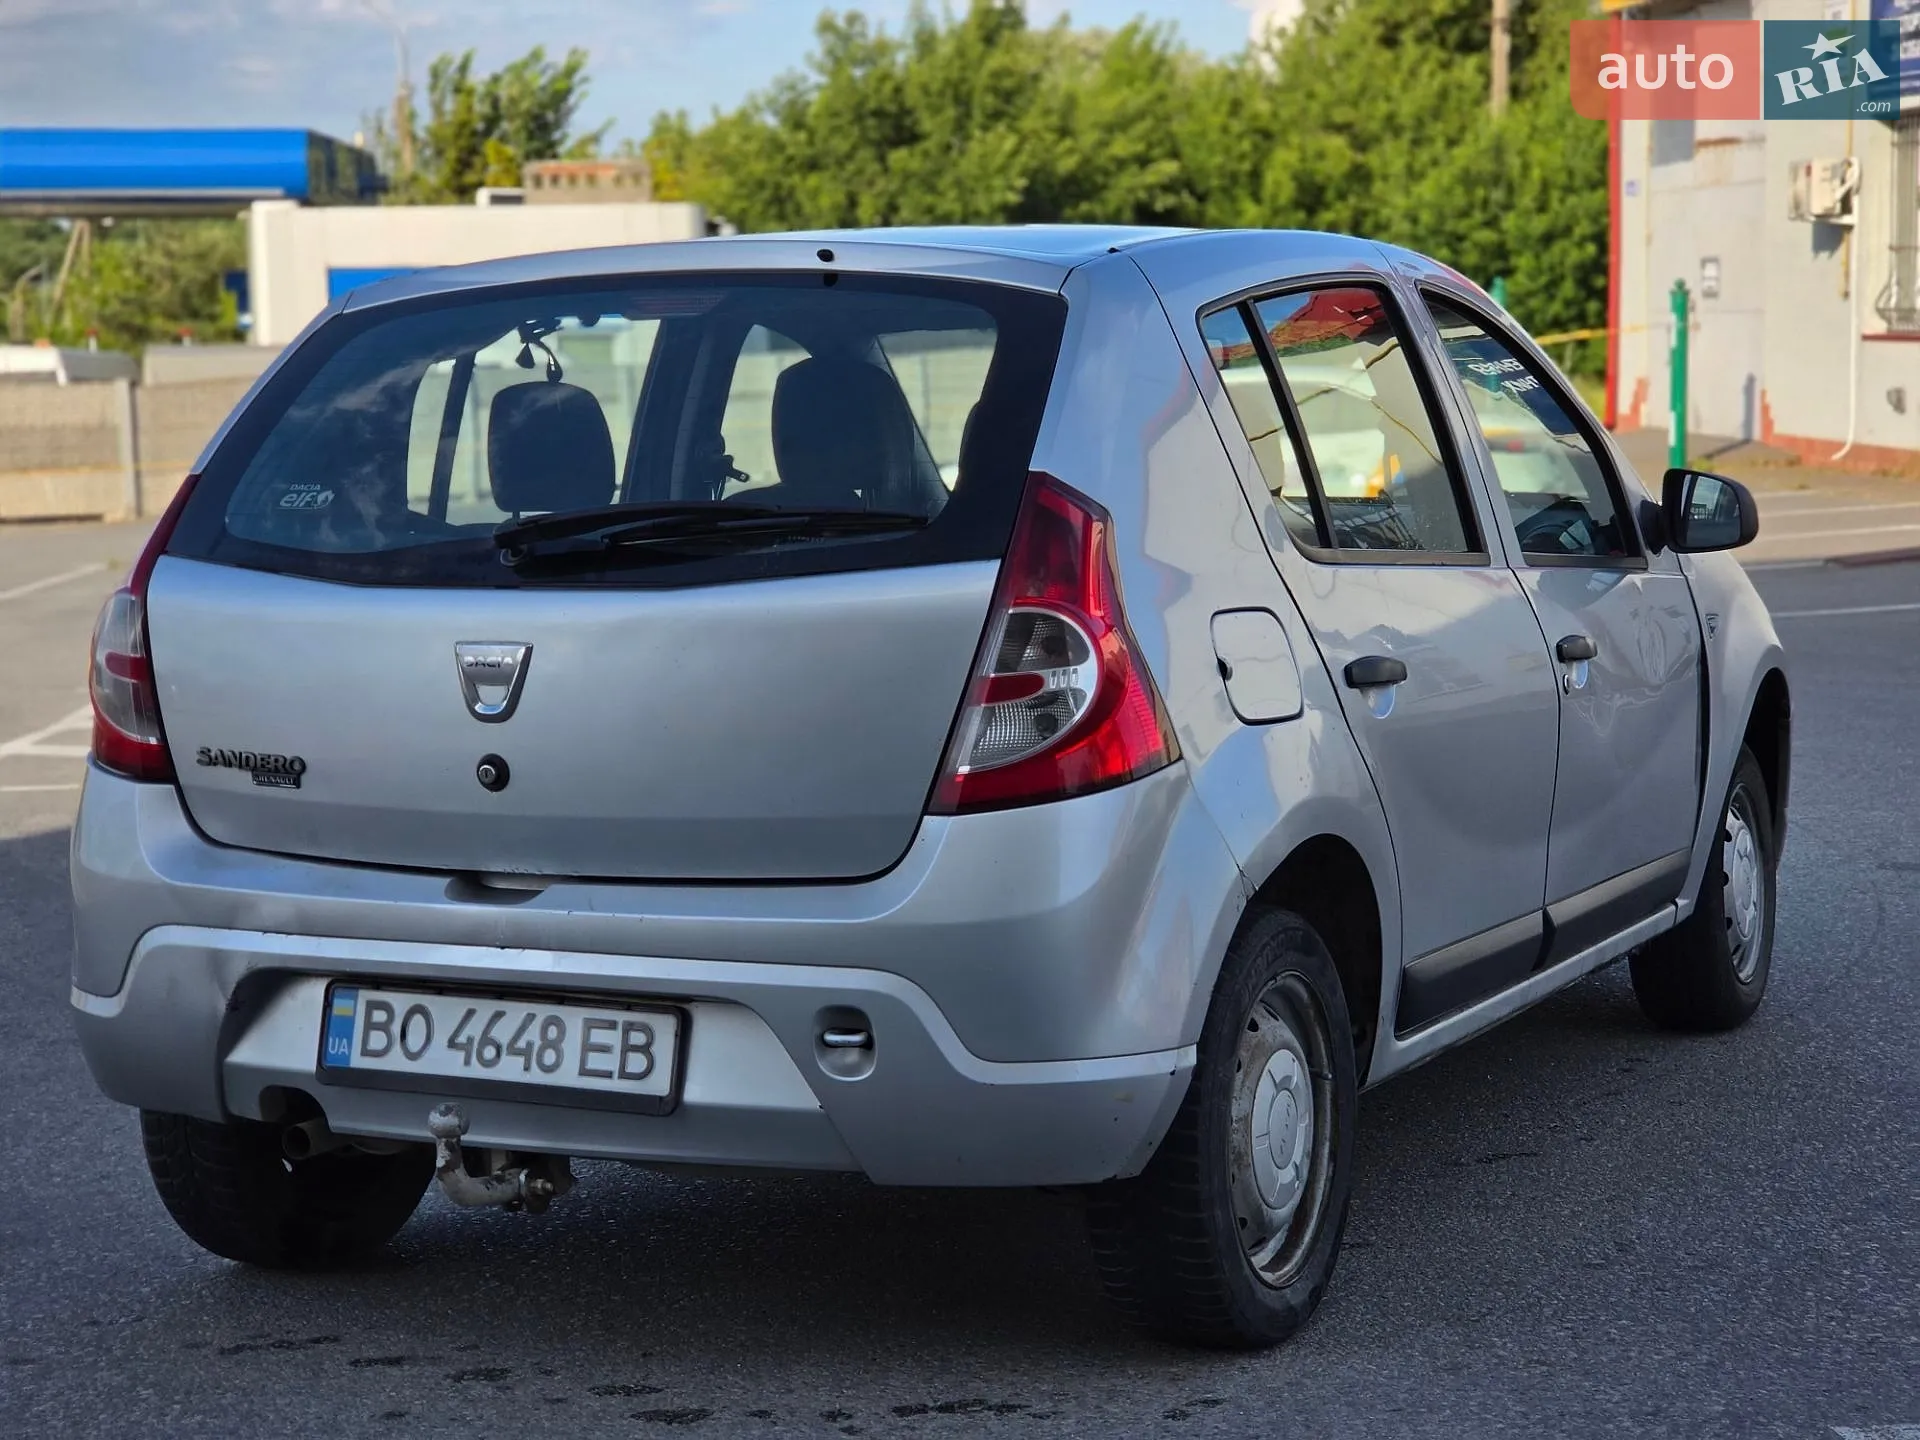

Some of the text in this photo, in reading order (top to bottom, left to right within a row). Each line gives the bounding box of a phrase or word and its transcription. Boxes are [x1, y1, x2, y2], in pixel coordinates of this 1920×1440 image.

[196, 746, 307, 776] SANDERO
[328, 1037, 349, 1055] UA
[360, 999, 656, 1081] BO 4648 EB
